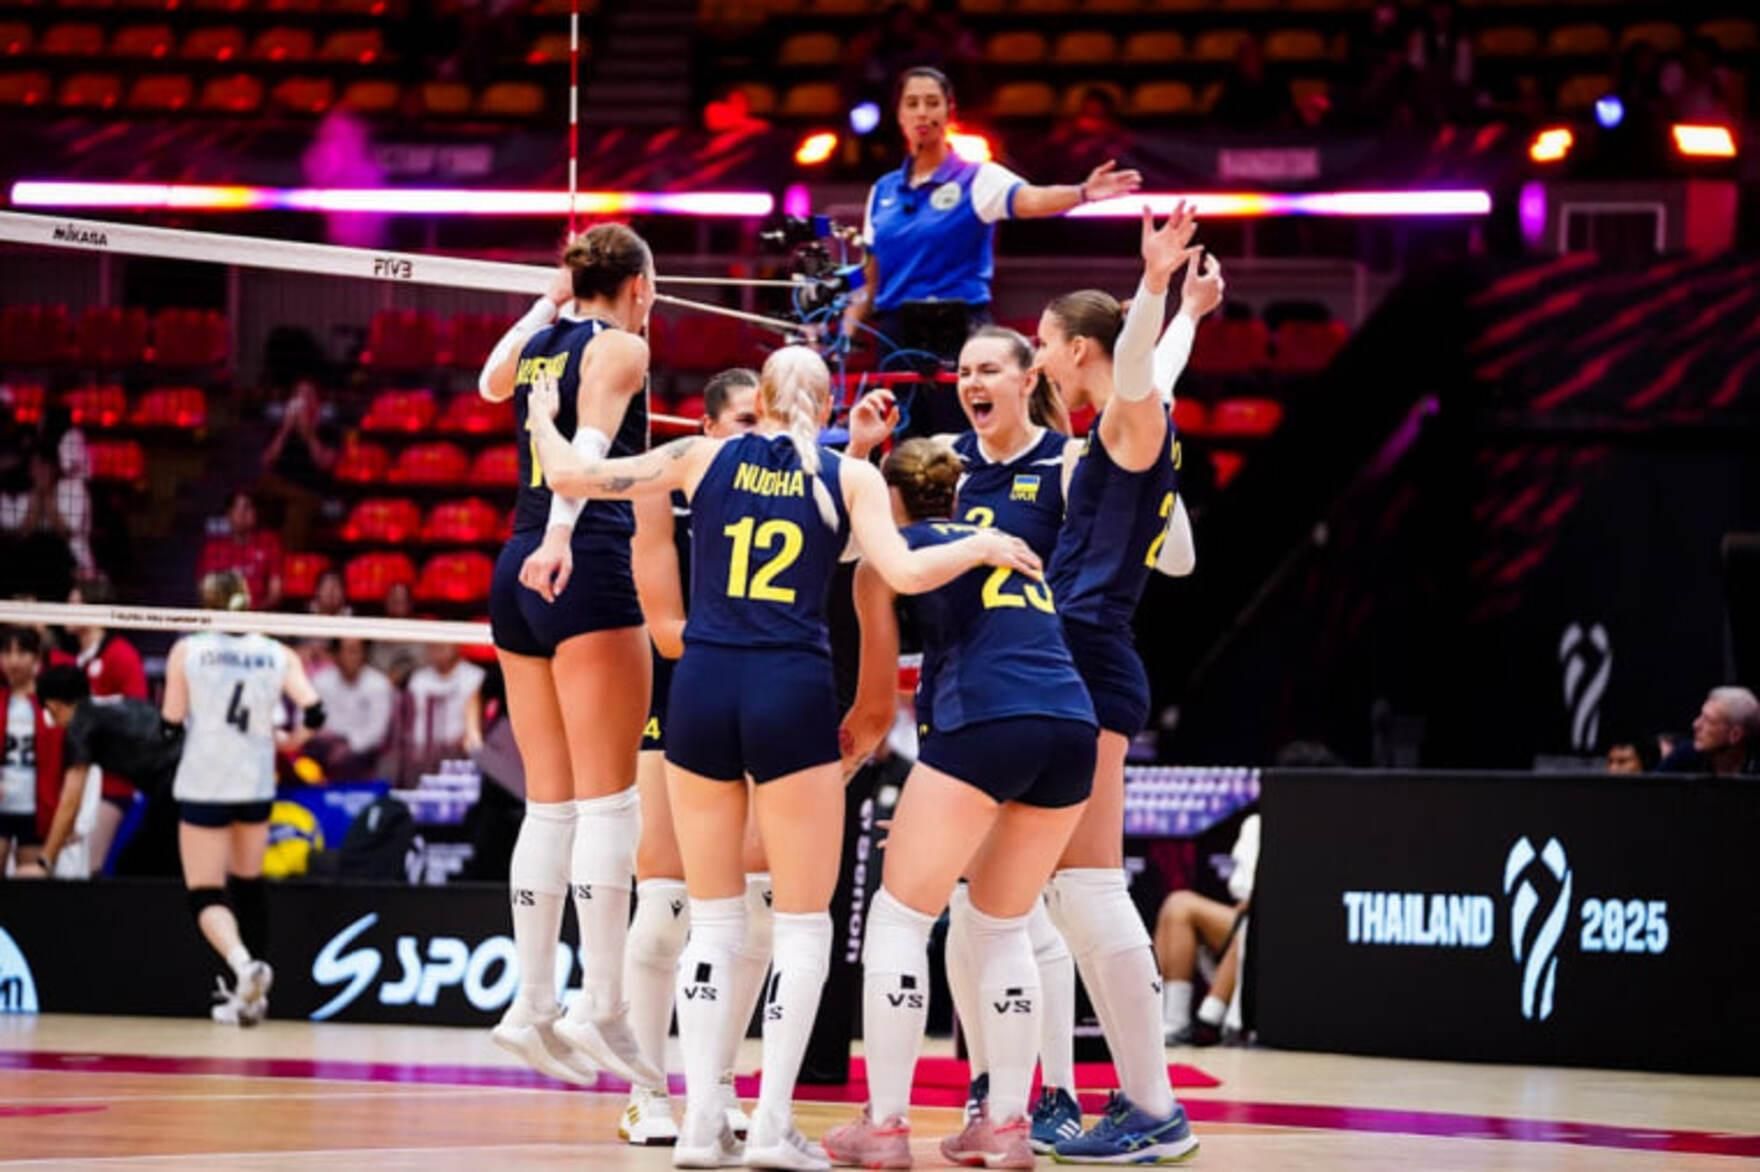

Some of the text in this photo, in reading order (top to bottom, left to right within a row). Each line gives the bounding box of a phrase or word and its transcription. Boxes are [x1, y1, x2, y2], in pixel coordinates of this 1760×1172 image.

[733, 461, 805, 497] NUDHA
[723, 516, 804, 604] 12
[226, 681, 249, 733] 4
[1343, 892, 1669, 954] THAILAND 2025
[684, 986, 718, 1001] VS
[886, 993, 925, 1009] VS
[993, 1000, 1032, 1014] VS
